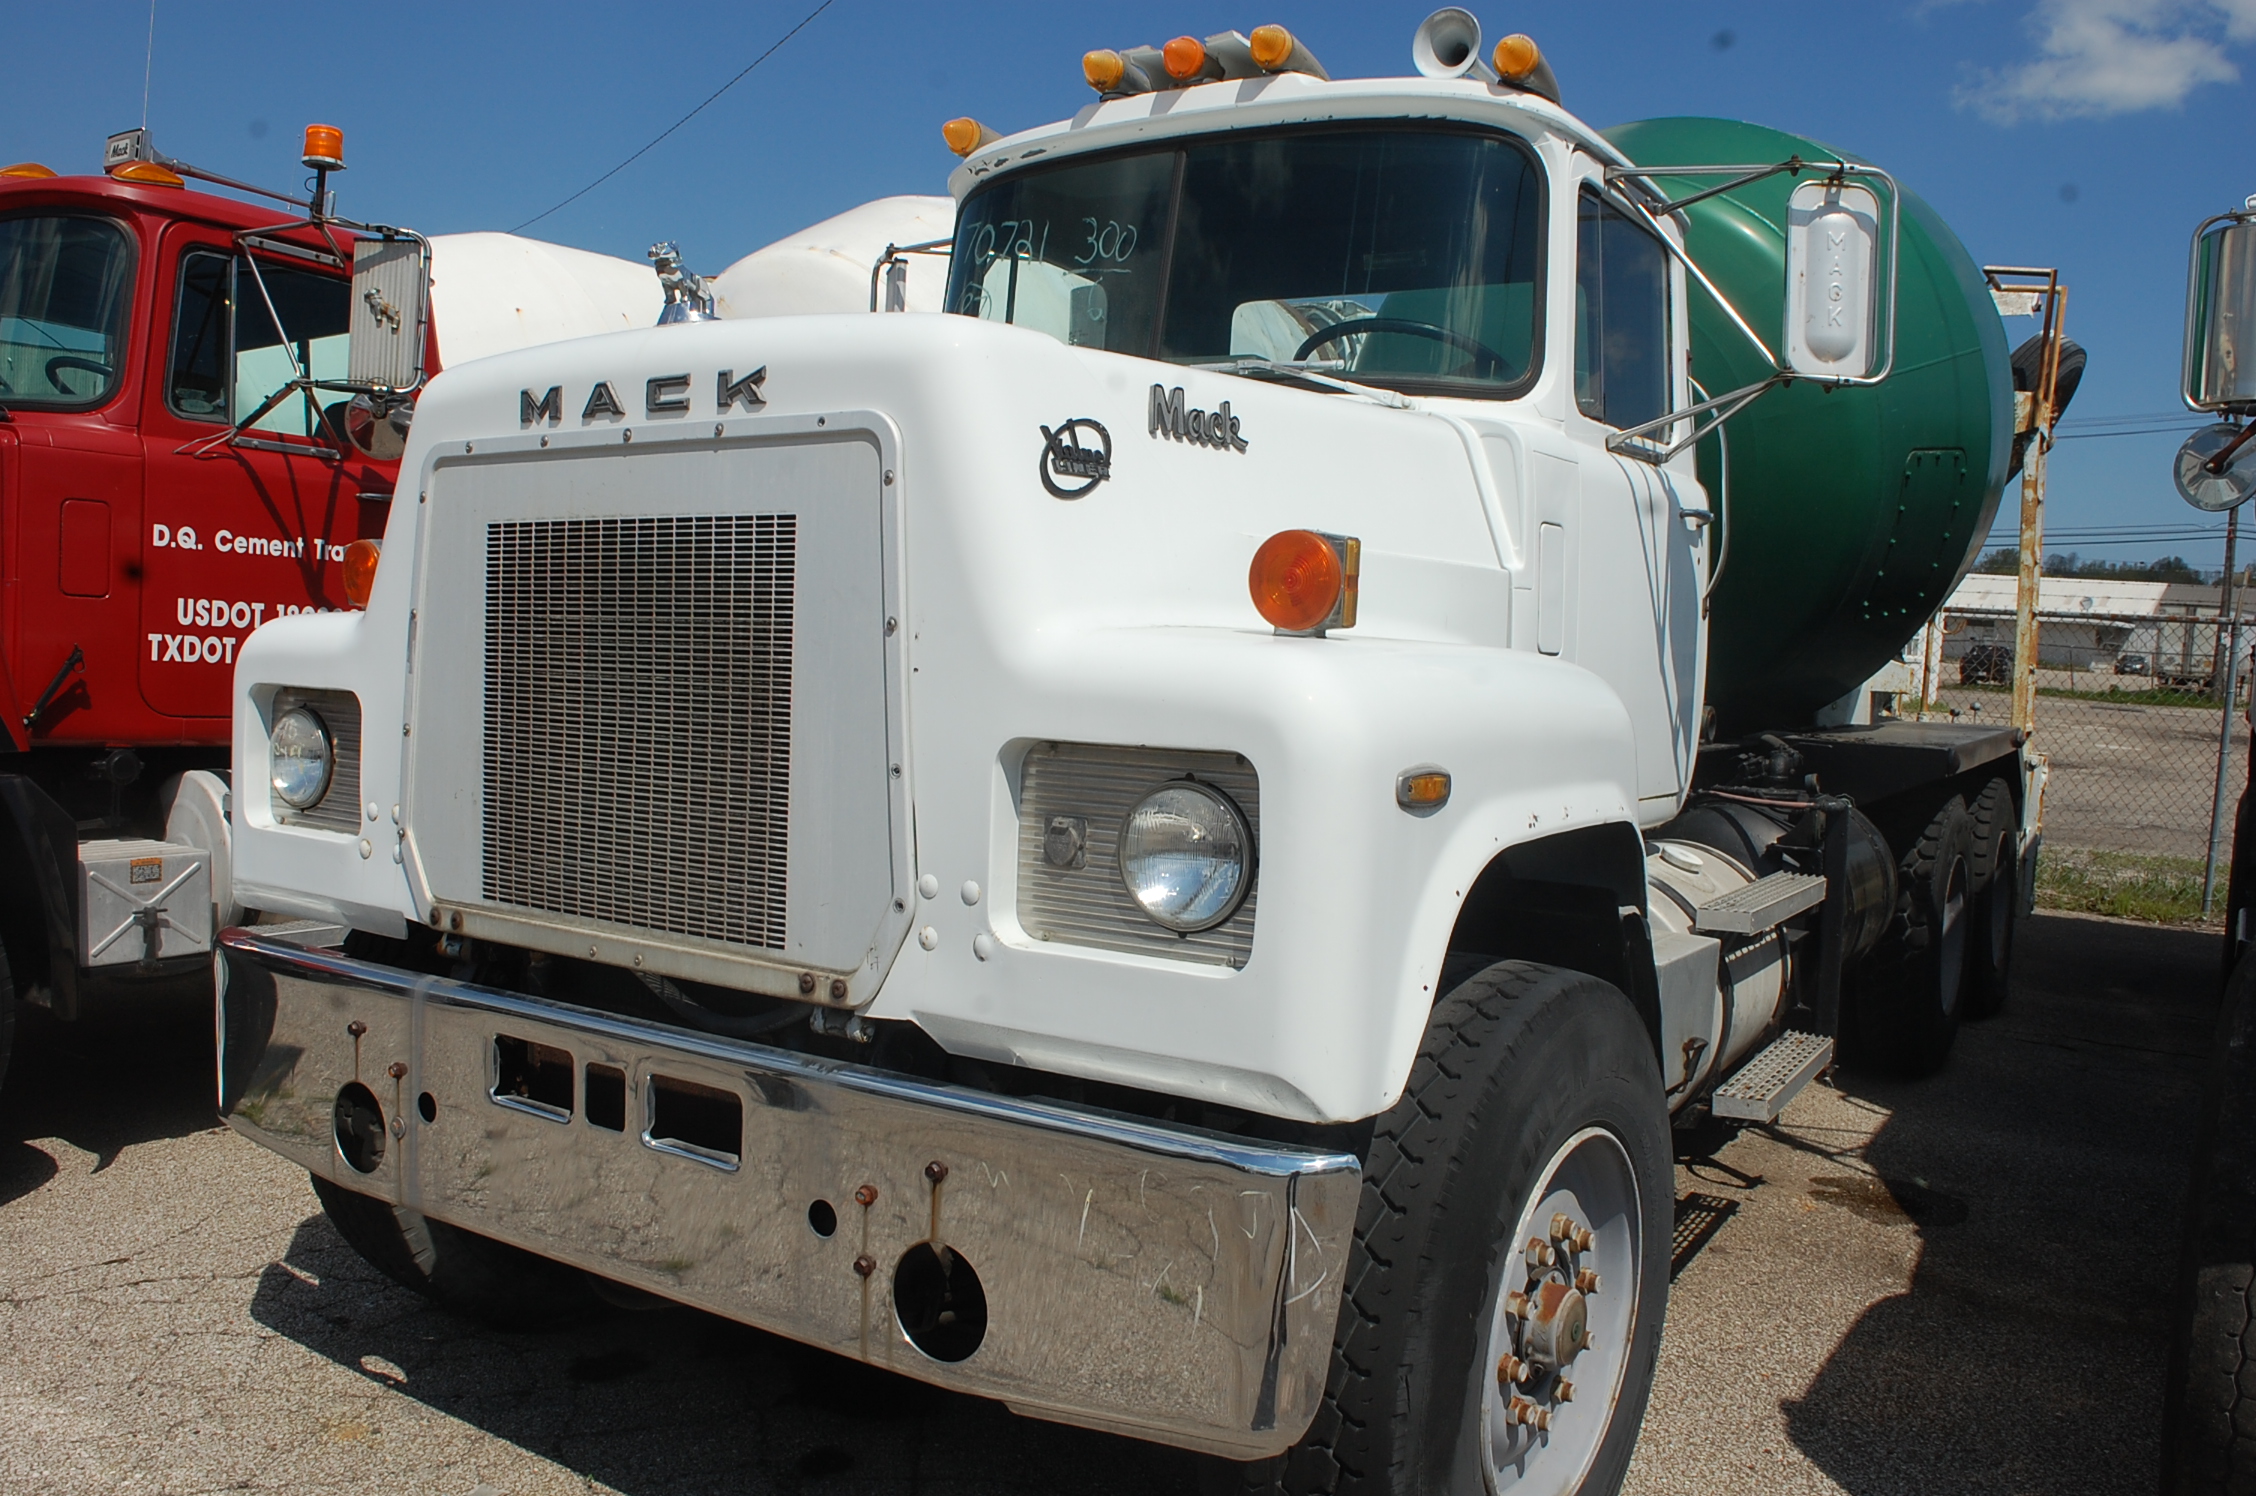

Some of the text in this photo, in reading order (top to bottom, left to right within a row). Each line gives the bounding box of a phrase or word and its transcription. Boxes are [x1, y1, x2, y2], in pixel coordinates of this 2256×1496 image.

[964, 216, 1137, 265] 70721 300
[1826, 231, 1846, 327] MACK
[520, 364, 767, 428] MACK
[1149, 384, 1249, 452] Mack
[153, 524, 345, 562] D.Q. Cement Tra
[177, 598, 265, 628] USDOT
[148, 633, 236, 664] TXDOT
